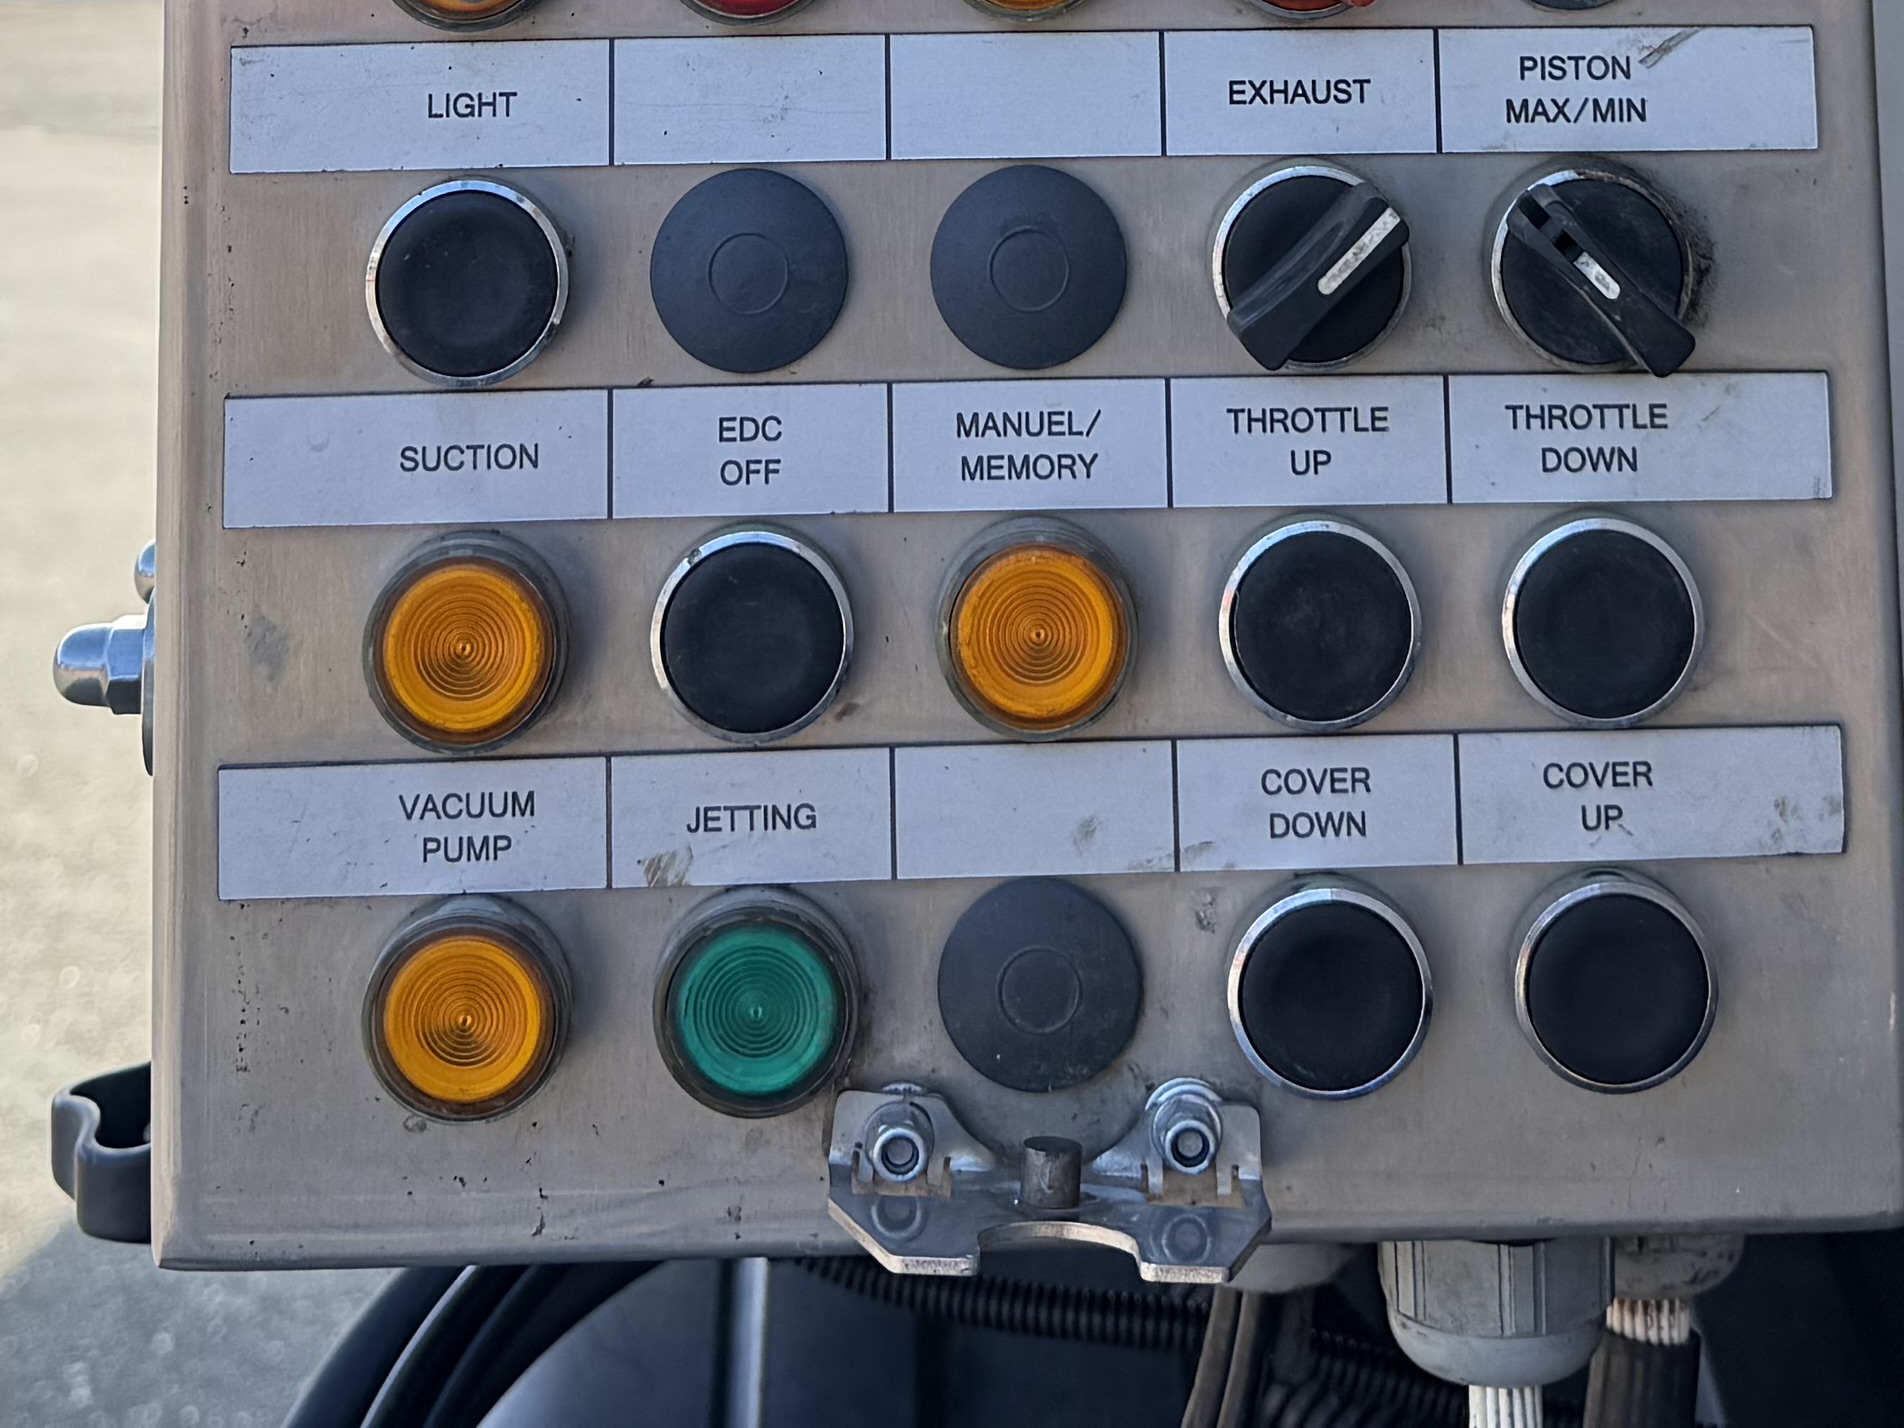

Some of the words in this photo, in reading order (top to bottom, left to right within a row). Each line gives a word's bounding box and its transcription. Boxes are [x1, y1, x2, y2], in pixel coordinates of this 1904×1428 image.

[1519, 55, 1632, 81] PISTON
[427, 91, 518, 119] LIGHT
[1228, 78, 1372, 106] EXHAUST
[1505, 96, 1647, 124] MAX/MIN
[718, 415, 783, 443] EDC
[956, 408, 1102, 439] MANUEL/
[1226, 406, 1390, 435] THROTTLE
[1504, 403, 1669, 431] THROTTLE
[399, 442, 539, 473] SUCTION
[961, 452, 1099, 482] MEMORY
[1290, 449, 1332, 476] UP
[1541, 446, 1638, 474] DOWN
[720, 458, 782, 486] OFF
[1260, 766, 1372, 796] COVER
[1543, 760, 1654, 790] COVER
[398, 790, 535, 821] VACUUM
[686, 802, 817, 834] JETTING
[1581, 804, 1624, 832] UP
[1269, 810, 1367, 840] DOWN
[422, 834, 512, 864] PUMP
